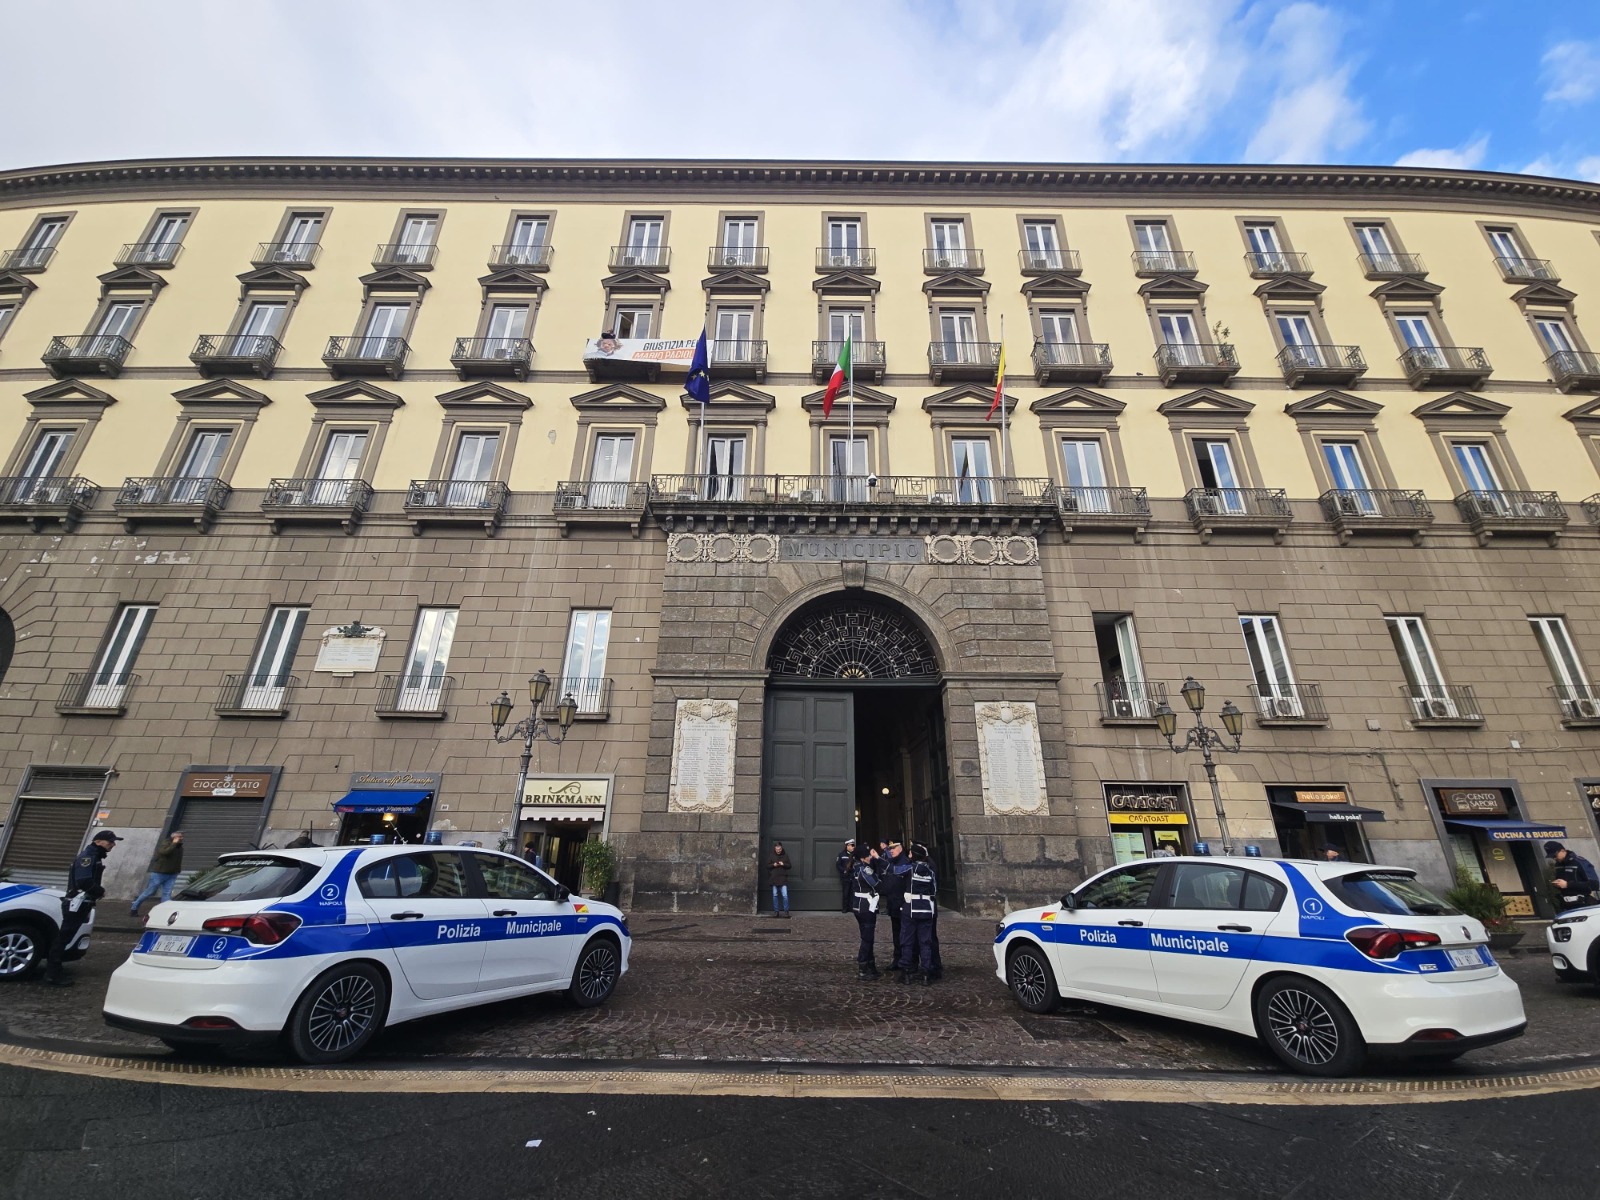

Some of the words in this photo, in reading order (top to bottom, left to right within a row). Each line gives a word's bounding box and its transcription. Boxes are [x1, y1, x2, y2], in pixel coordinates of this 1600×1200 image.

[643, 340, 684, 351] GIUSTIZIA
[634, 351, 663, 360] MARIO
[665, 350, 695, 360] PACIOL
[788, 543, 919, 558] MUNICIPIO
[525, 794, 602, 804] BRINKMANN
[1302, 792, 1320, 800] hello
[1111, 794, 1178, 811] CAPATOAST
[1128, 815, 1169, 823] CAPATOAST
[326, 888, 334, 897] 2
[437, 924, 481, 939] Polizia
[506, 920, 562, 935] Municipale
[1079, 929, 1117, 944] Polizia
[1150, 933, 1229, 953] Municipale
